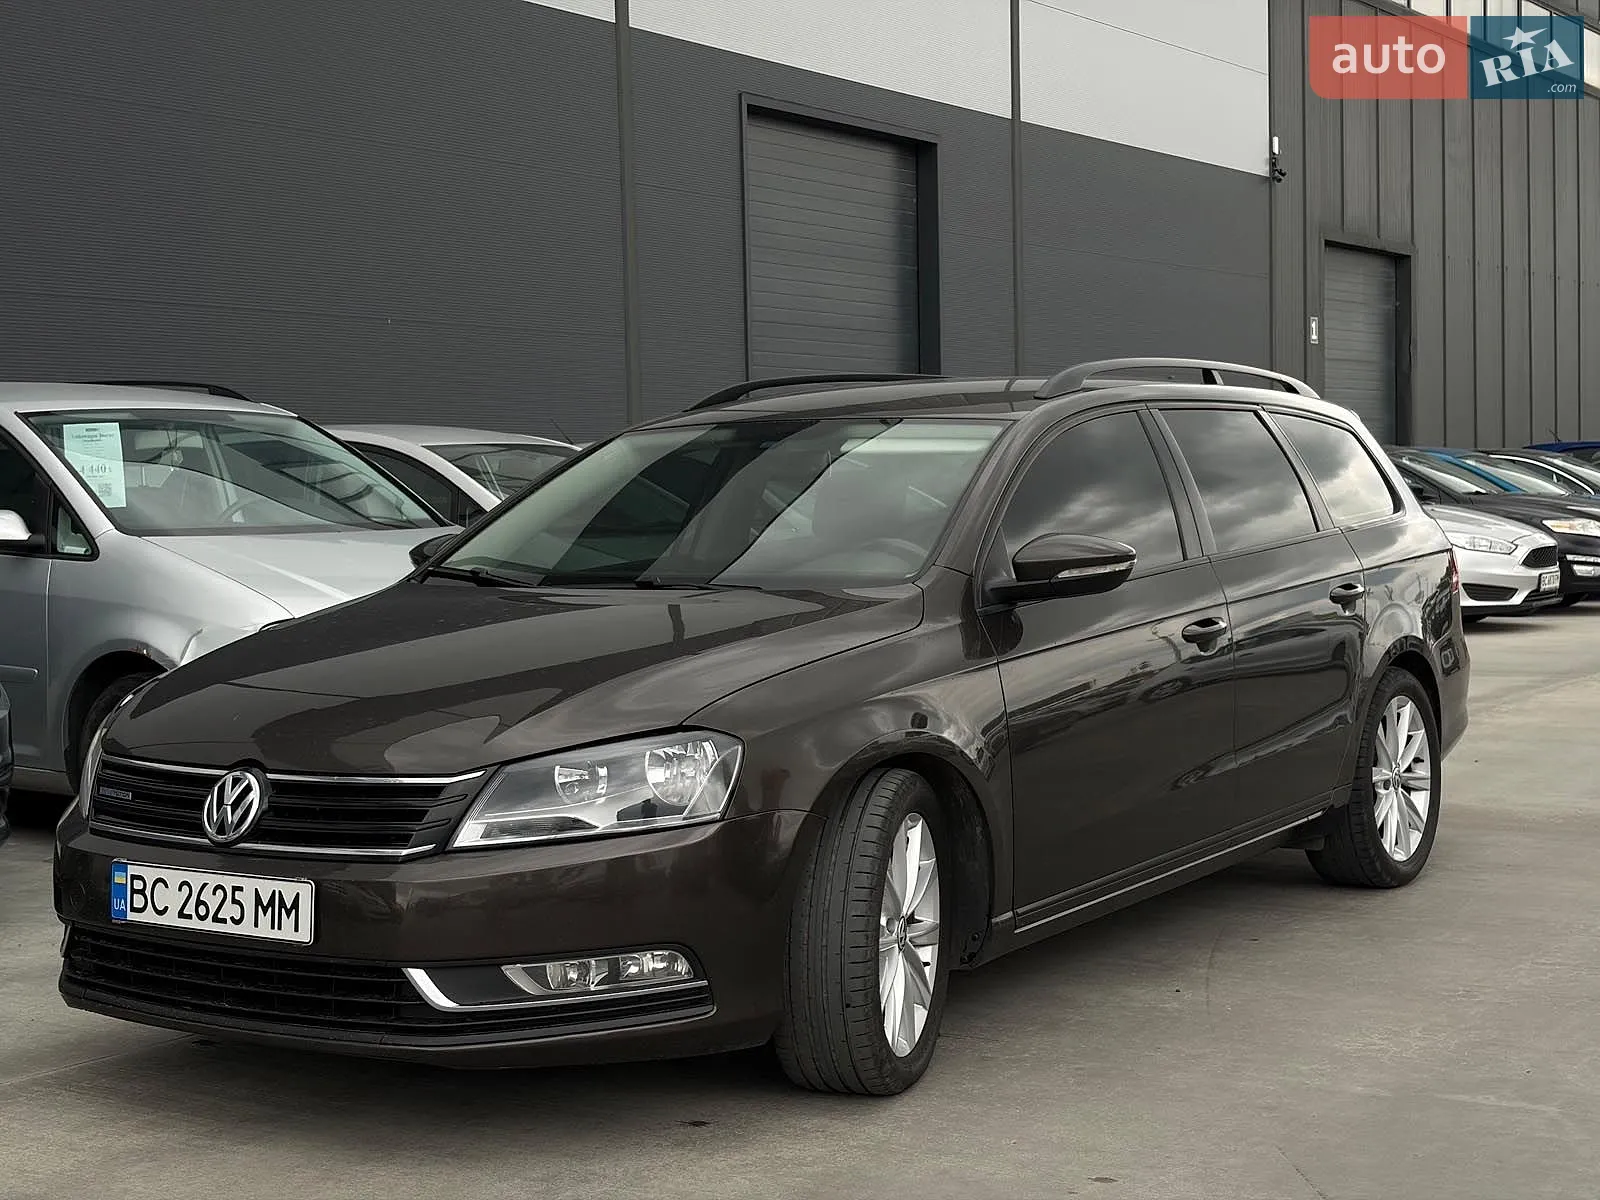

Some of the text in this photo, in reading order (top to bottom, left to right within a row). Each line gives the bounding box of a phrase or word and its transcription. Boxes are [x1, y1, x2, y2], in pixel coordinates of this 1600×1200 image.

[114, 898, 126, 911] UA
[129, 873, 300, 932] BC 2625 MM
